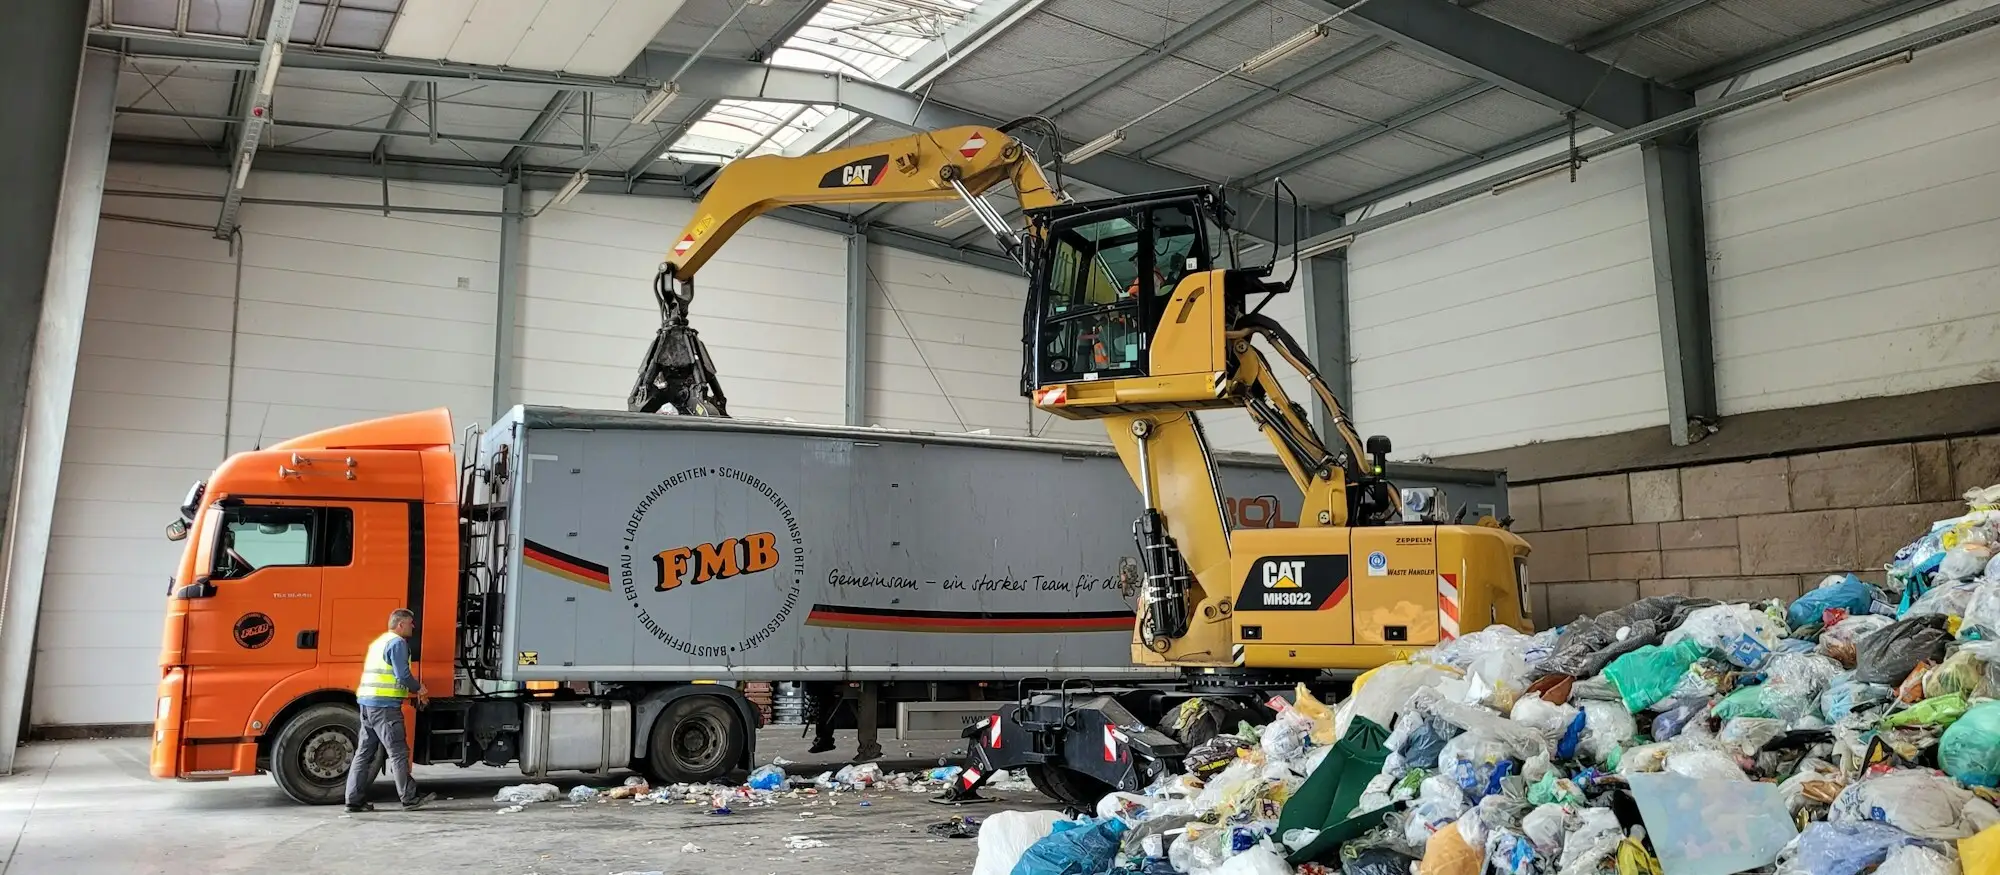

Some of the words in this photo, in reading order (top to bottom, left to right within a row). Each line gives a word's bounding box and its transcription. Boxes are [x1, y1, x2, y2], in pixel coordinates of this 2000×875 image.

[842, 165, 872, 185] CAT
[624, 466, 707, 542] LADEKRANARBEITEN
[620, 553, 638, 601] ERDBAU
[652, 531, 780, 592] FMB
[828, 568, 919, 590] Gemeinsam
[942, 575, 967, 591] ein
[971, 573, 1028, 592] starkes
[1032, 574, 1071, 593] Team
[1075, 574, 1099, 598] für
[1262, 560, 1306, 589] CAT
[738, 586, 801, 654] FUHRGESCHÄFT
[1263, 592, 1312, 606] MH3022
[636, 608, 728, 658] BAUSTOFFHANDEL
